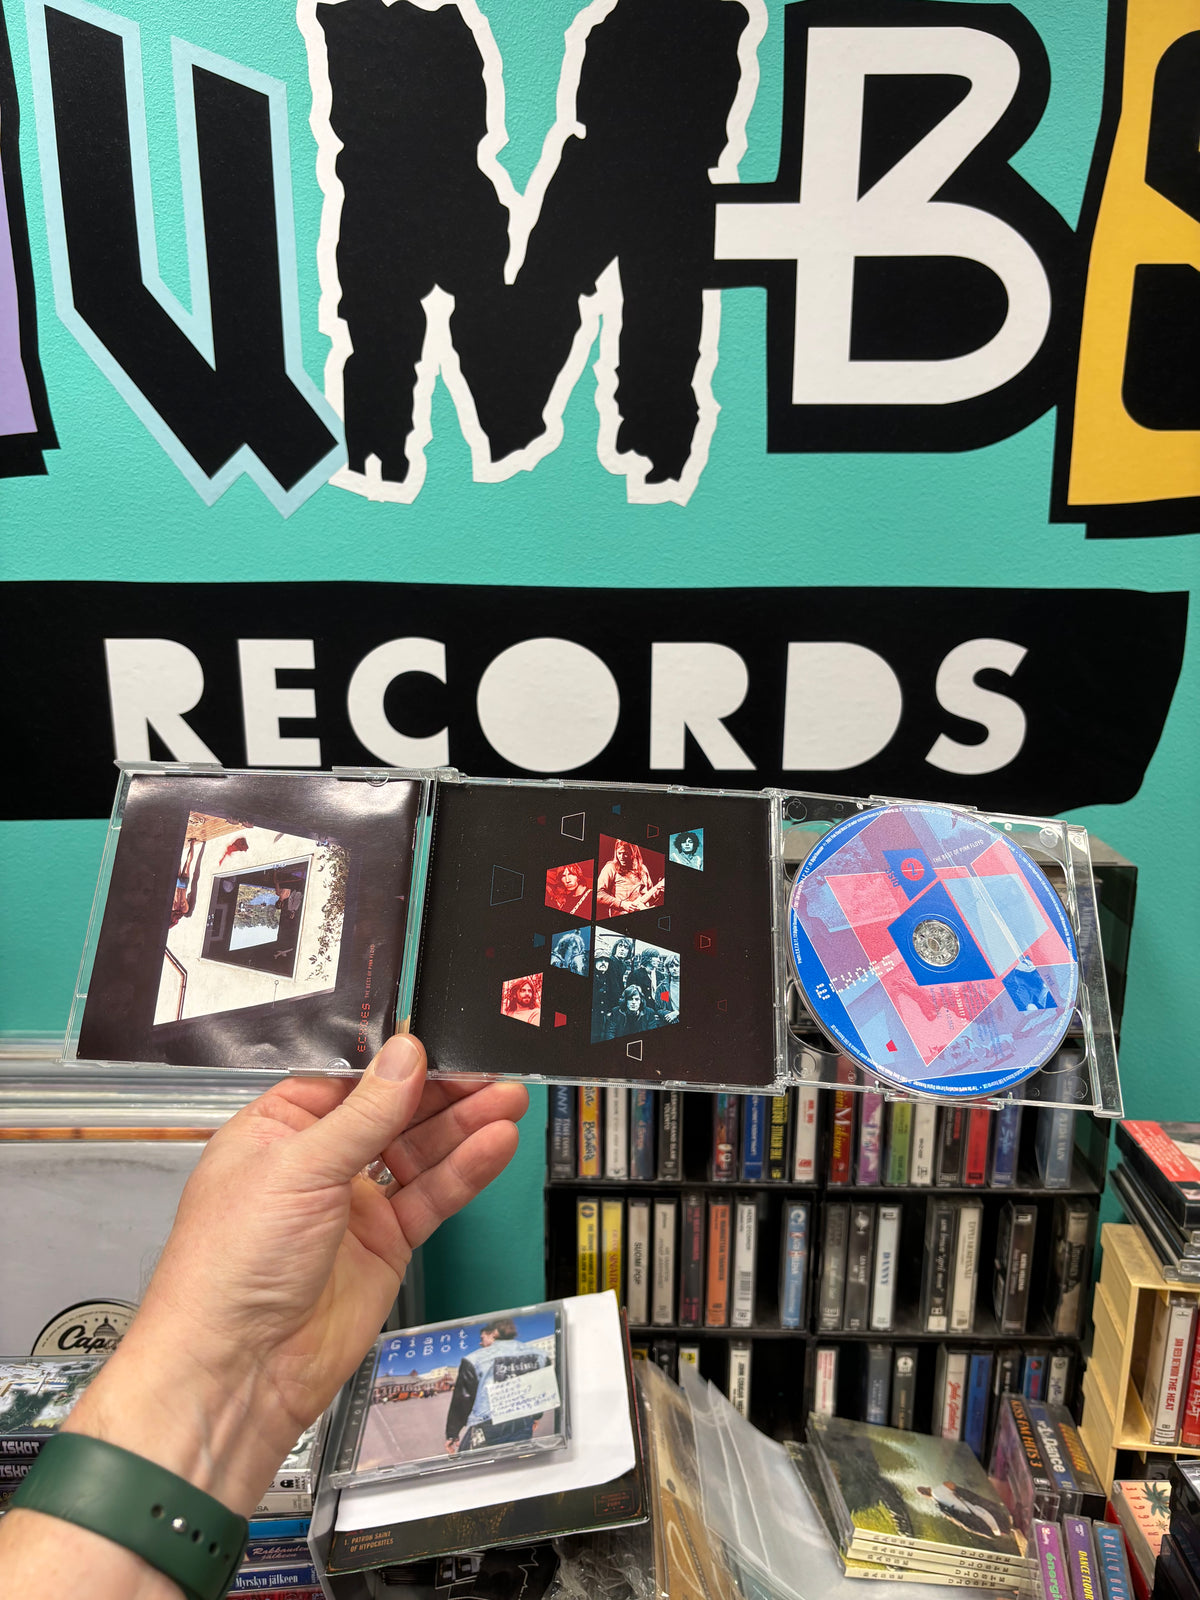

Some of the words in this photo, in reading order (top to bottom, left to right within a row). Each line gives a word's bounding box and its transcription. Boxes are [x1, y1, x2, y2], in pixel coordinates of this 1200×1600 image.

[103, 636, 1028, 774] RECORDS
[969, 839, 984, 851] FLOYD
[357, 1003, 370, 1052] ECHOES
[558, 1087, 567, 1114] NNY
[634, 1242, 642, 1268] SUOMI
[634, 1268, 642, 1286] POP
[391, 1329, 468, 1350] Giant
[1168, 1377, 1178, 1391] THE
[1010, 1400, 1026, 1419] KISS
[1165, 1392, 1177, 1412] HEAT
[1016, 1418, 1032, 1434] FM
[1022, 1432, 1040, 1462] HITS
[1044, 1437, 1066, 1473] Dance
[1031, 1459, 1042, 1468] 3
[350, 1545, 358, 1553] OF
[358, 1538, 394, 1551] HYPOCRITES
[352, 1535, 373, 1545] PATRON
[374, 1531, 391, 1540] SAINT
[1078, 1550, 1090, 1572] DANCE
[235, 1574, 267, 1589] Myrskyn
[268, 1574, 299, 1588] jälkeen
[1081, 1571, 1095, 1600] FLOOR
